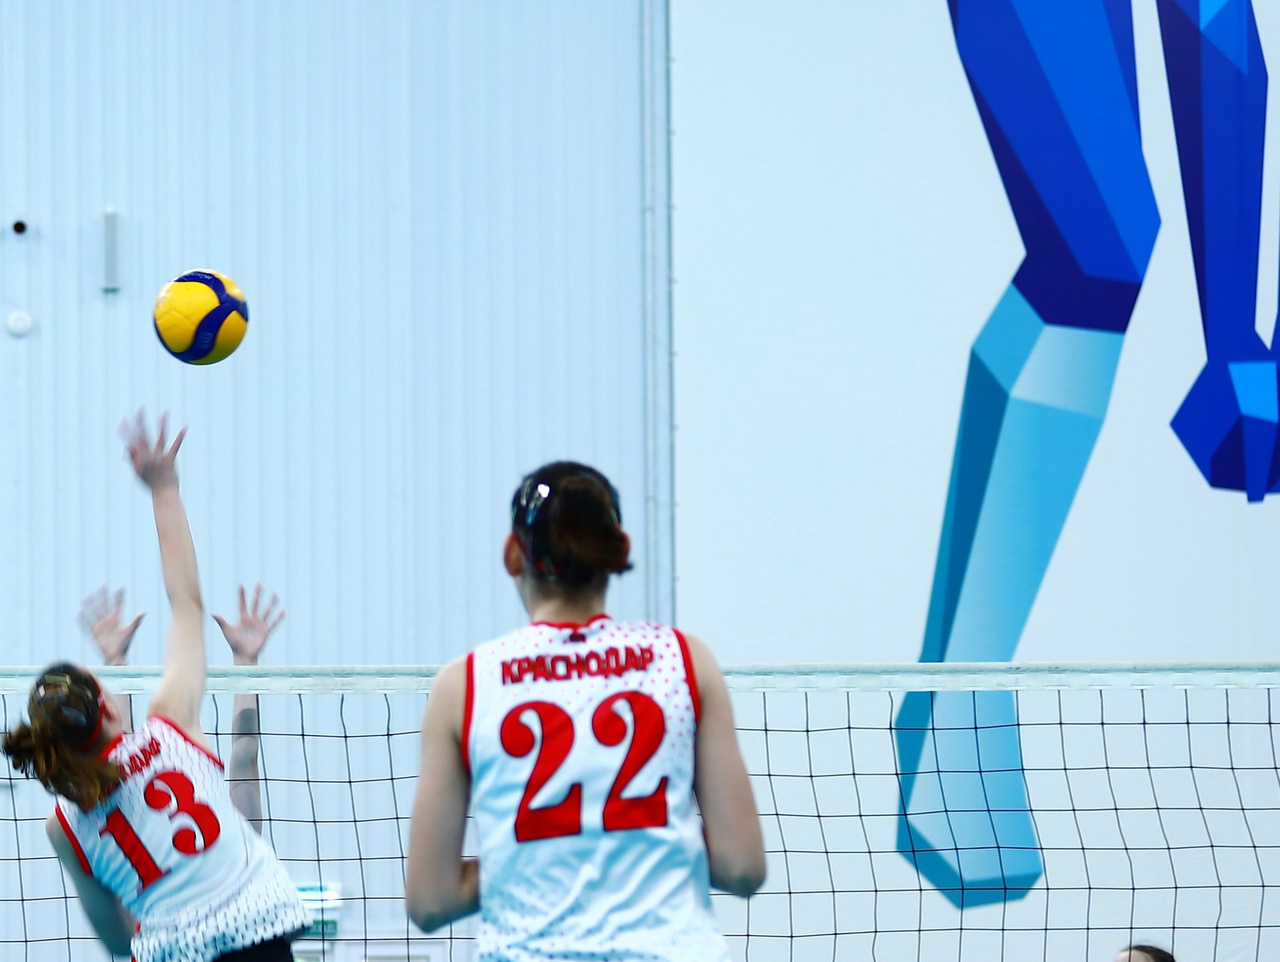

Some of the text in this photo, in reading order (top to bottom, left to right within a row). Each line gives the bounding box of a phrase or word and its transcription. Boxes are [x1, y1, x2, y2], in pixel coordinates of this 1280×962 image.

[500, 643, 654, 685] КРАСНОДАР
[500, 690, 668, 842] 22
[99, 771, 221, 896] 13
